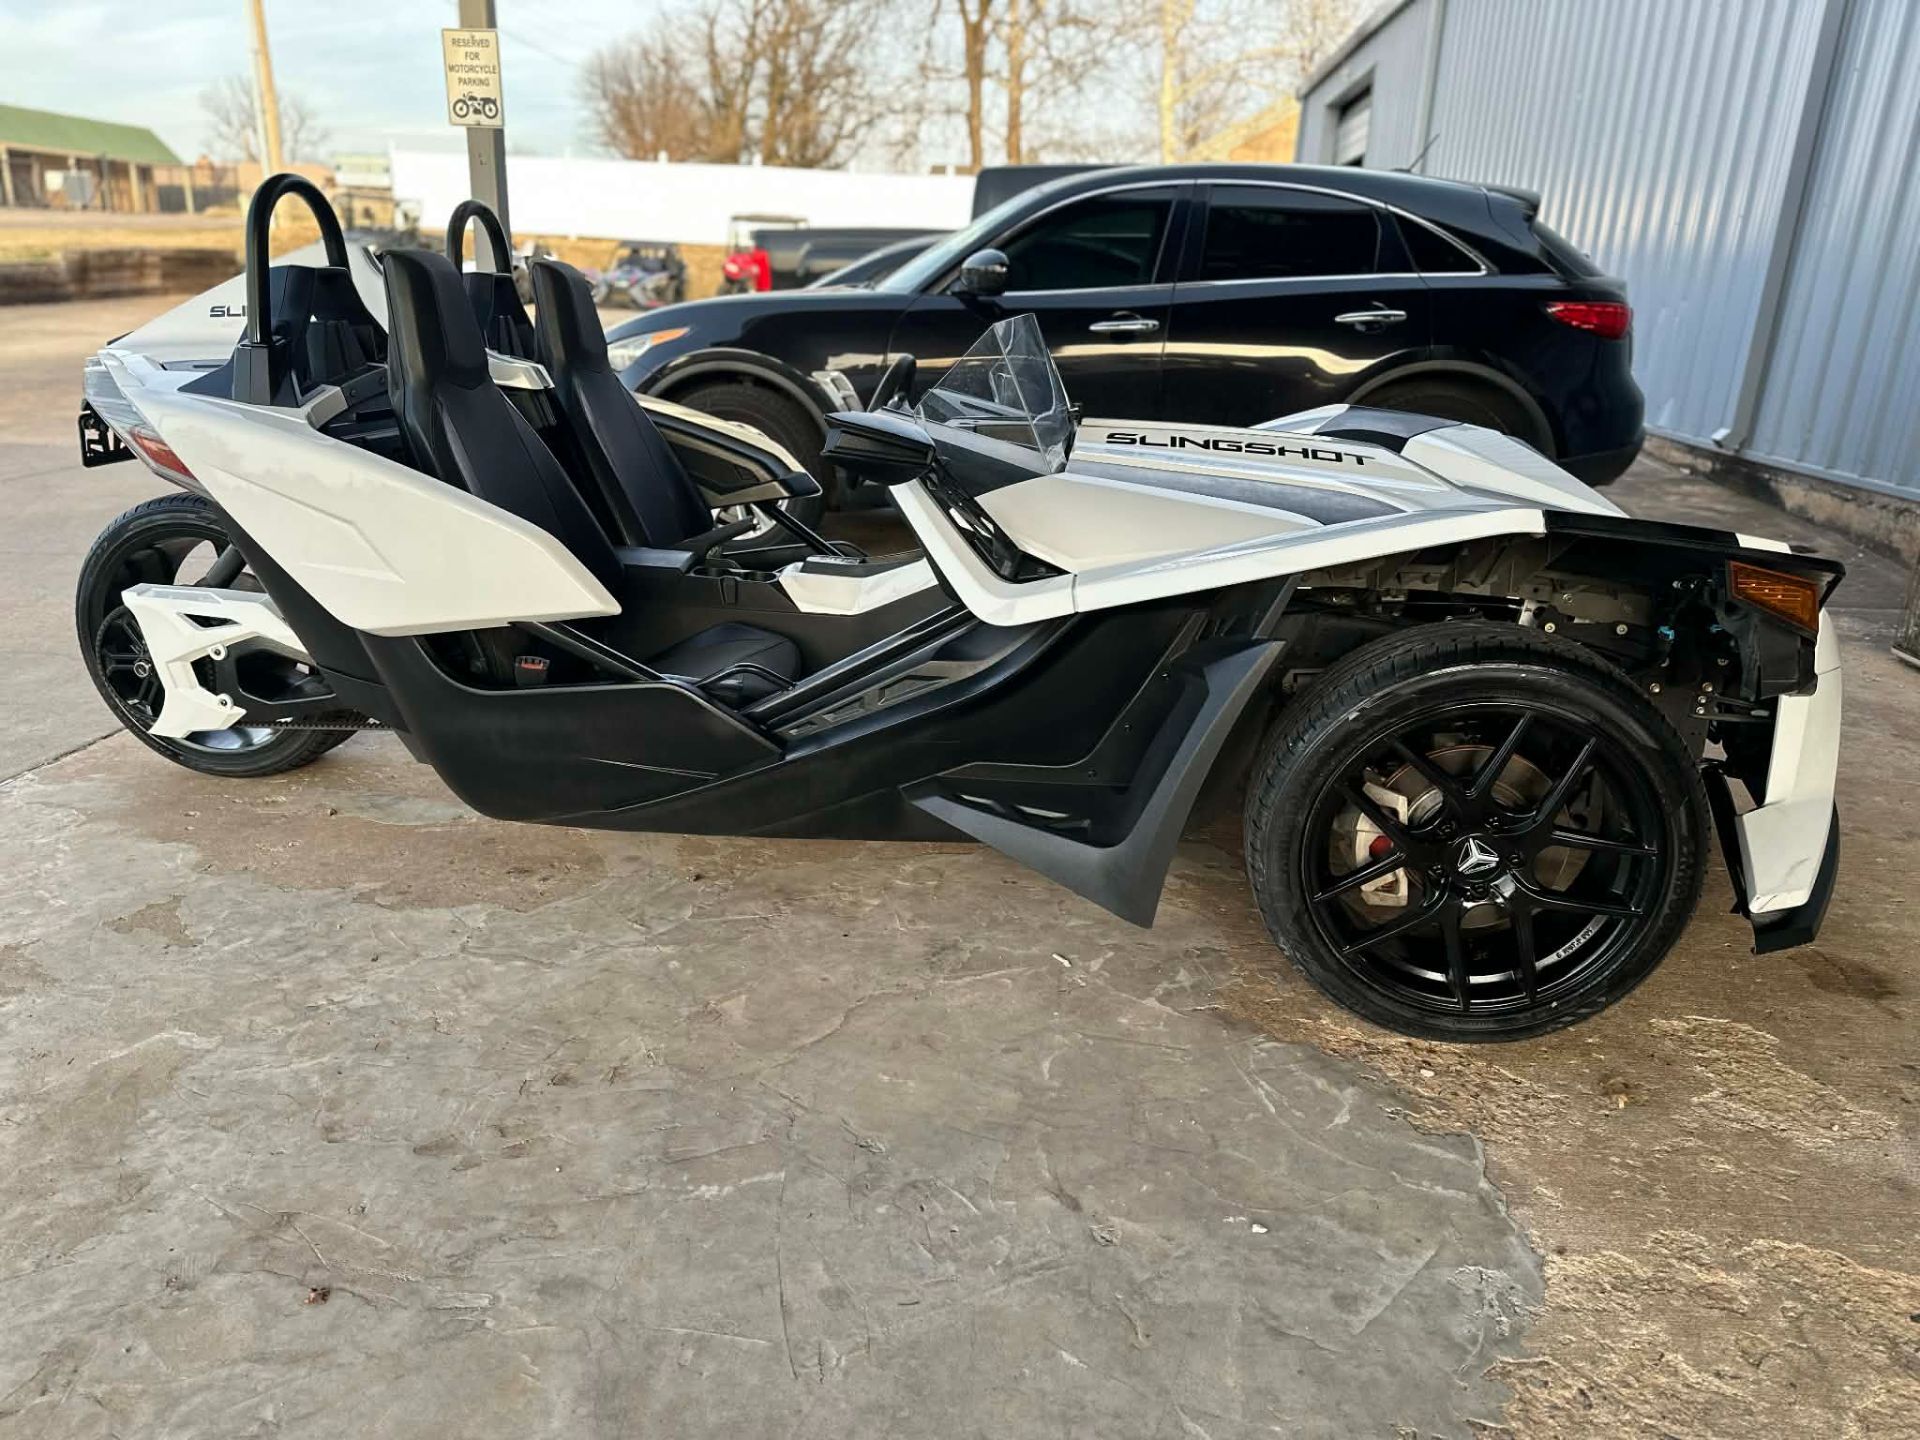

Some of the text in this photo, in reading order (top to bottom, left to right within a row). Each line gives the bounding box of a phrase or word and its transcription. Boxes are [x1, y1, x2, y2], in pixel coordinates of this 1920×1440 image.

[451, 38, 490, 48] RESERVED
[464, 51, 480, 61] FOR
[448, 64, 497, 75] MOTORCYCLE
[458, 77, 490, 87] PARKING
[210, 305, 248, 318] SLI
[1106, 432, 1376, 465] SLINGSHOT
